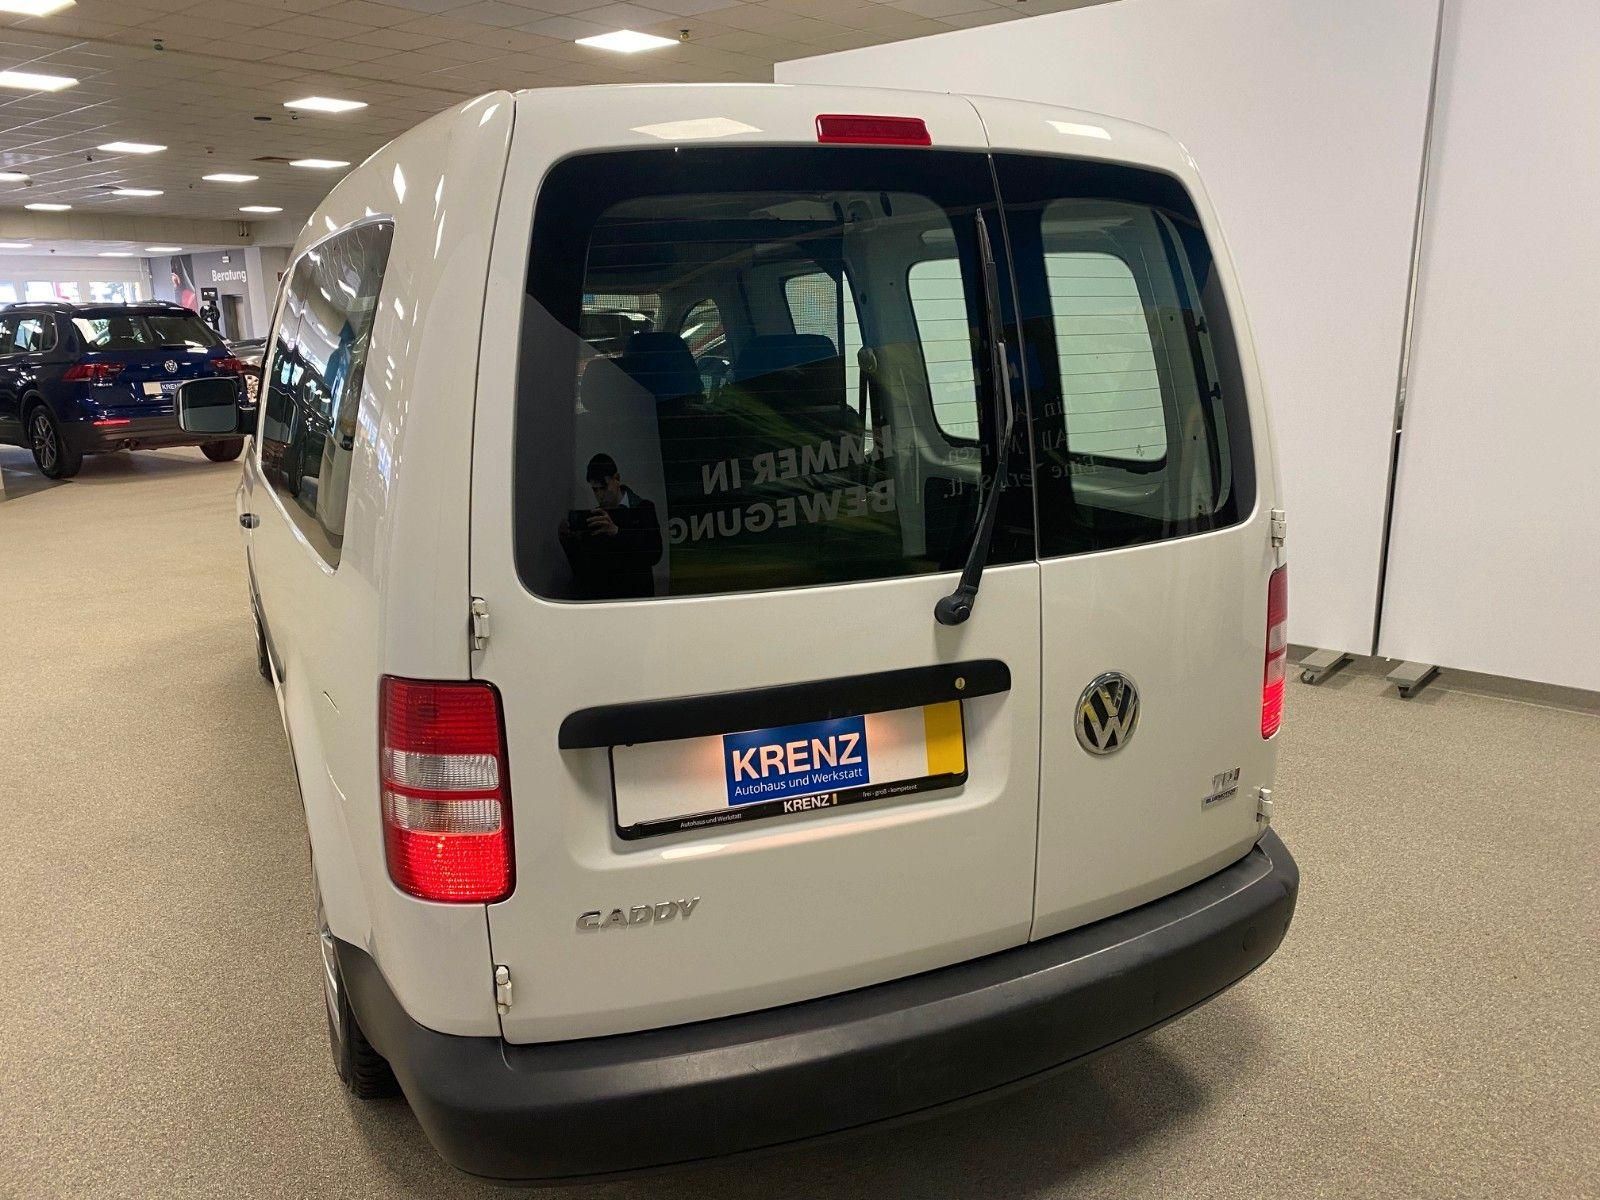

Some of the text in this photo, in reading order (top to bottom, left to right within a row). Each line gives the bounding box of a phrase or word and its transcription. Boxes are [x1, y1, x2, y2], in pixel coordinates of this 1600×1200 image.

[211, 269, 247, 283] Beratung
[732, 732, 862, 781] KRENZ
[734, 767, 863, 797] Autohaus und Werkstatt
[783, 794, 830, 813] KRENZ
[680, 813, 742, 829] Autohaus und Werkstatt
[576, 896, 701, 929] CADDY
